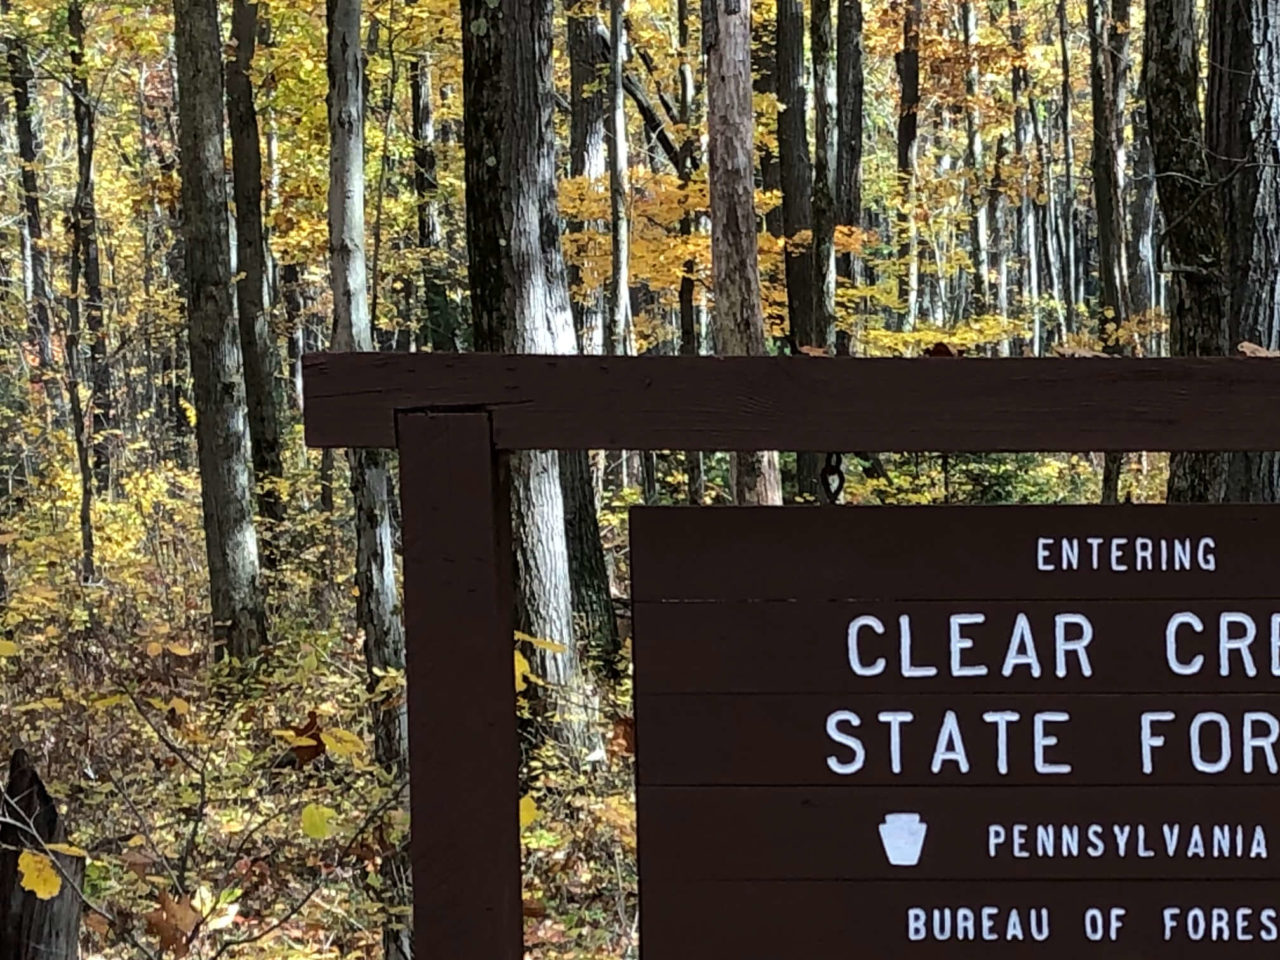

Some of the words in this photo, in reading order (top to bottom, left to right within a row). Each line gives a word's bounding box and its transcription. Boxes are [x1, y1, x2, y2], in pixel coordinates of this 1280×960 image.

[1038, 538, 1215, 570] ENTERING
[848, 613, 1092, 677] CLEAR
[827, 711, 1071, 774] STATE
[989, 824, 1267, 858] PENNSYLVANIA
[908, 907, 1048, 940] BUREAU
[1086, 908, 1125, 940] OF
